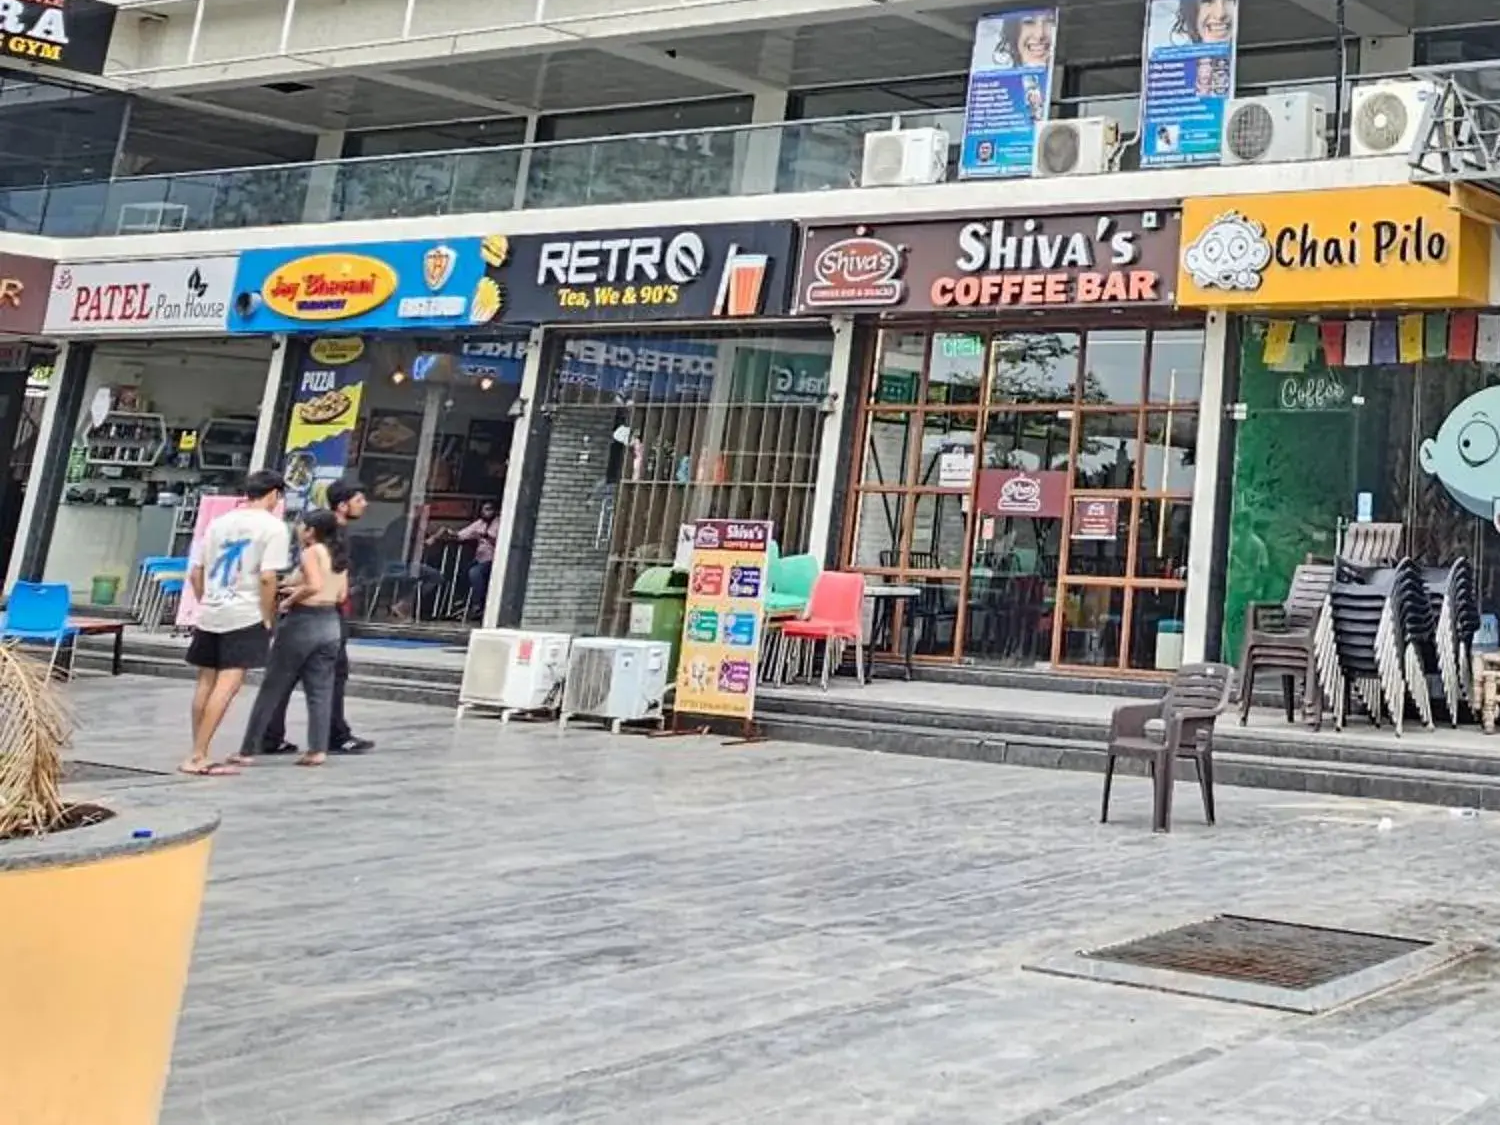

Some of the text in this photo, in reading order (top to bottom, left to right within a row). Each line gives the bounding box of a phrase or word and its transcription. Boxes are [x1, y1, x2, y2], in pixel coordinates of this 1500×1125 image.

[9, 36, 62, 60] GYM
[1275, 216, 1446, 268] Chai Pilo
[537, 231, 705, 285] RETRO
[821, 248, 893, 278] Shiva's
[71, 283, 225, 322] PATEL Pan House
[270, 275, 301, 302] Jay
[558, 284, 680, 309] Tea, We & 90'S
[930, 269, 1159, 307] COFFEE BAR
[301, 370, 336, 392] PIZZA
